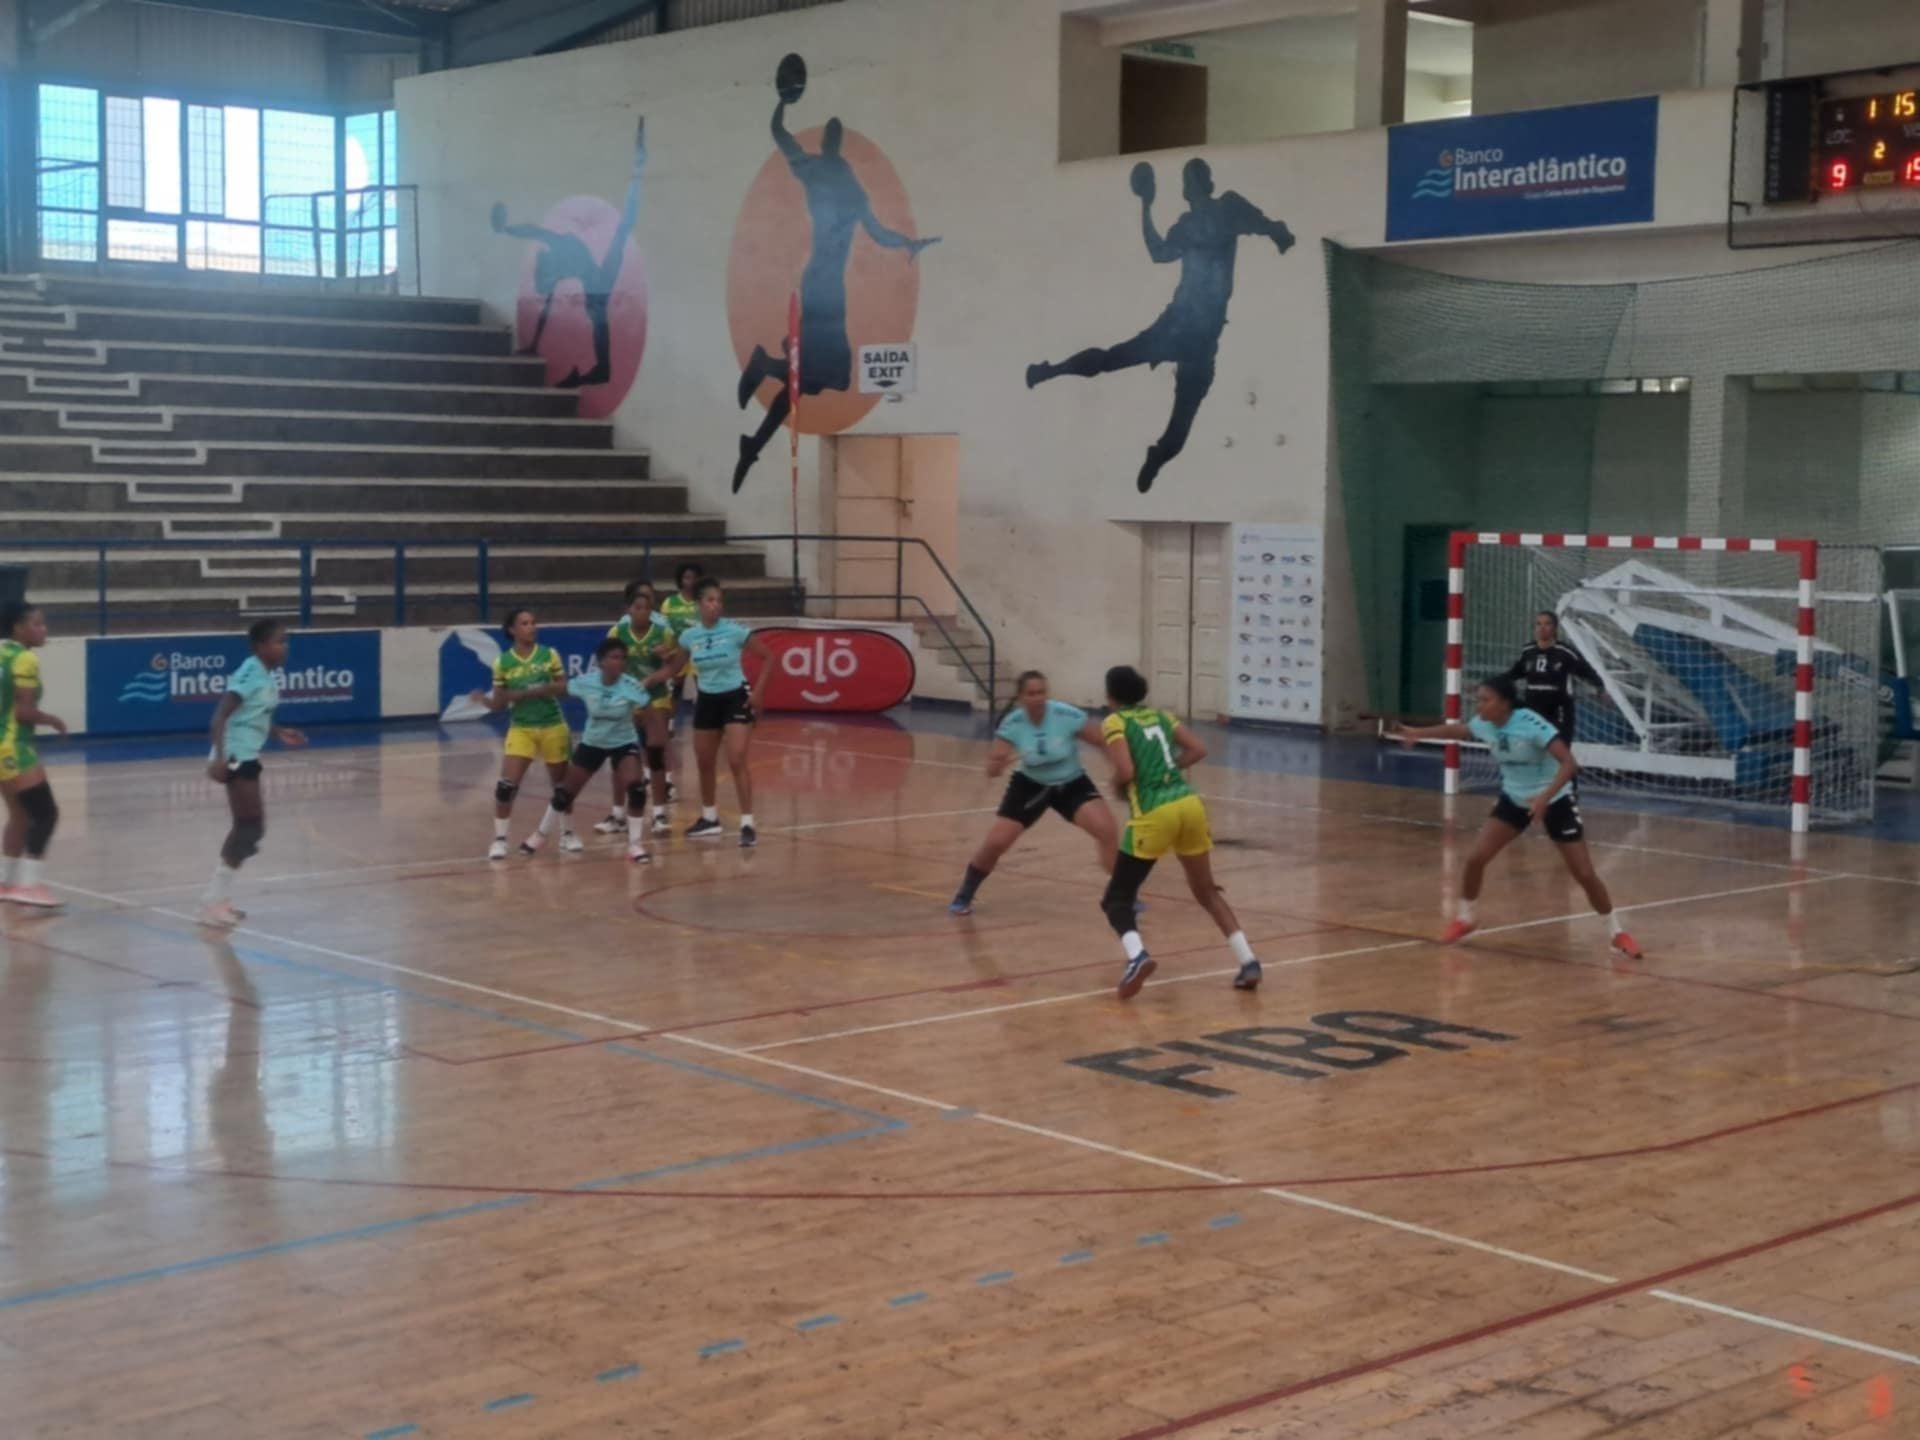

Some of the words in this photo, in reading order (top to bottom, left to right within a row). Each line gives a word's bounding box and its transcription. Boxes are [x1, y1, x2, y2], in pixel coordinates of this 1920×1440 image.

[1894, 92, 1915, 116] 15
[1455, 148, 1503, 166] Banco
[1873, 141, 1885, 158] 2
[1455, 154, 1627, 190] Interatlântico
[1832, 164, 1847, 187] 9
[868, 366, 904, 378] EXIT
[171, 651, 225, 670] Banco
[1536, 658, 1547, 672] 12
[170, 665, 354, 695] Interântico
[1143, 725, 1175, 769] 7
[1065, 1010, 1521, 1098] FIBA
